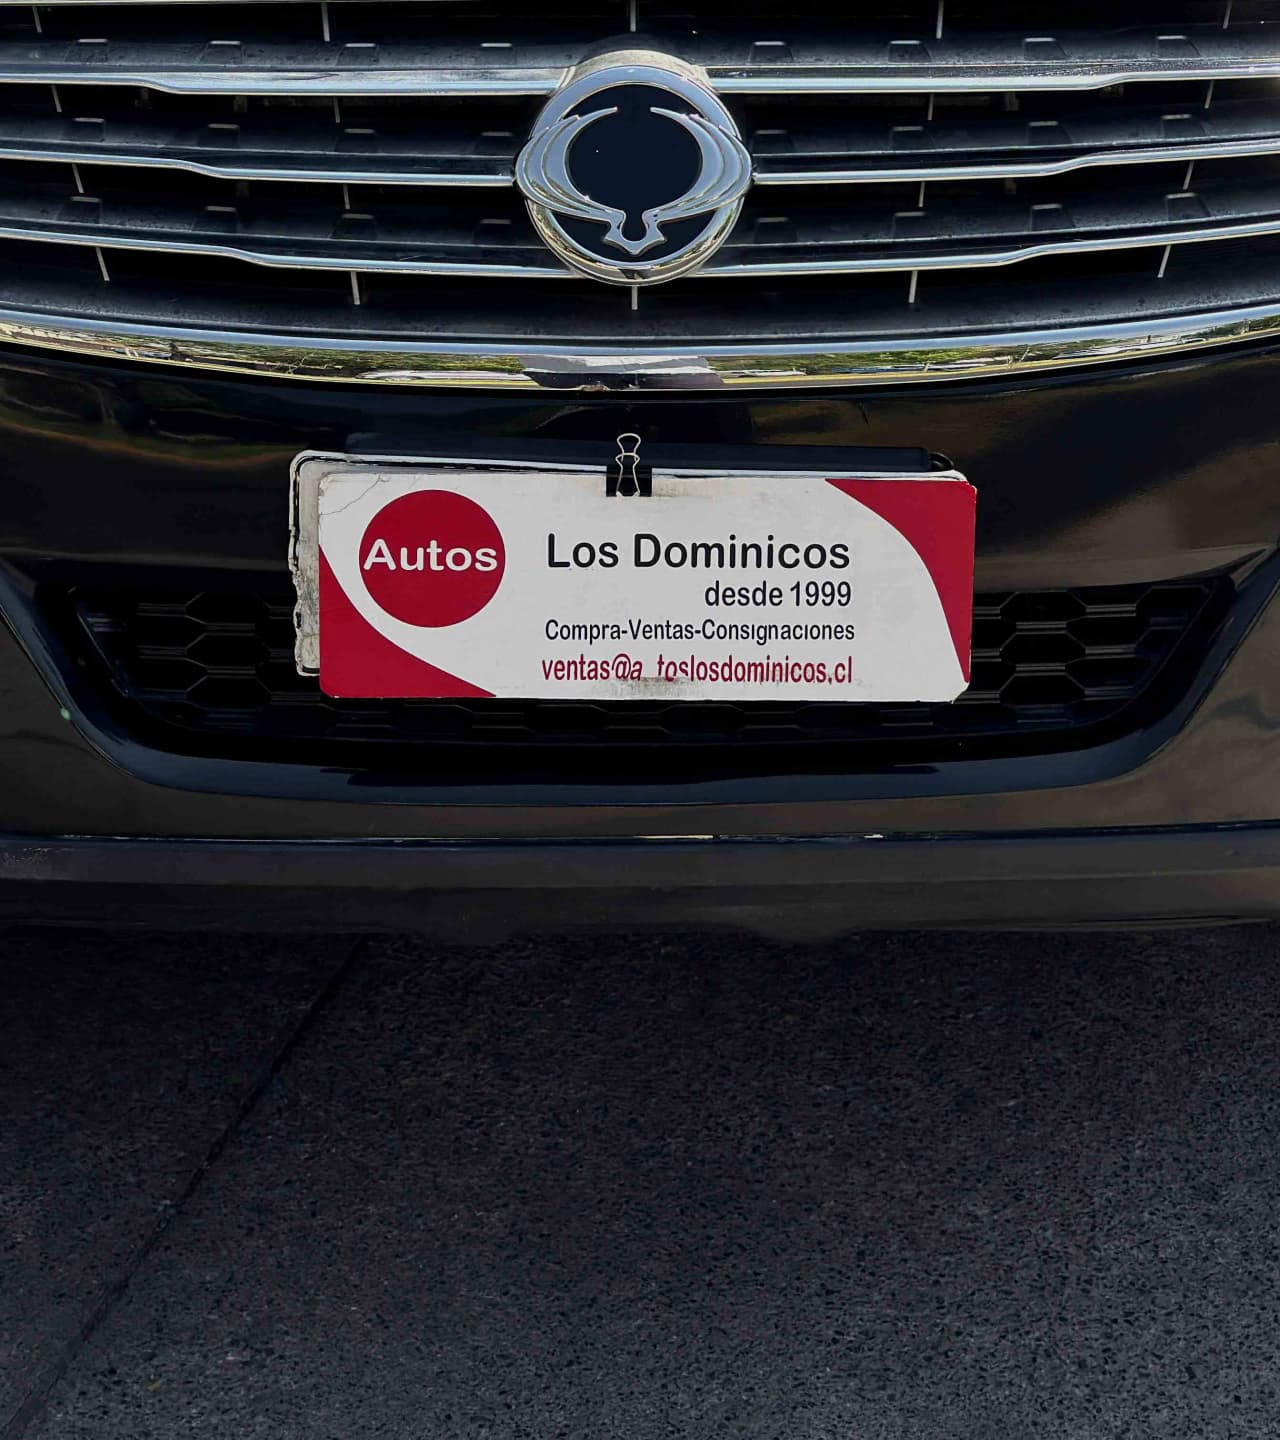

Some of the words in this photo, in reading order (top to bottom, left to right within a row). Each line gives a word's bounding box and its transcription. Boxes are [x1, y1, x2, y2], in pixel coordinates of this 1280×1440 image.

[362, 538, 498, 574] Autos
[546, 533, 619, 569] Los
[633, 532, 850, 570] Dominicos
[704, 580, 783, 608] desde
[789, 580, 852, 608] 1999
